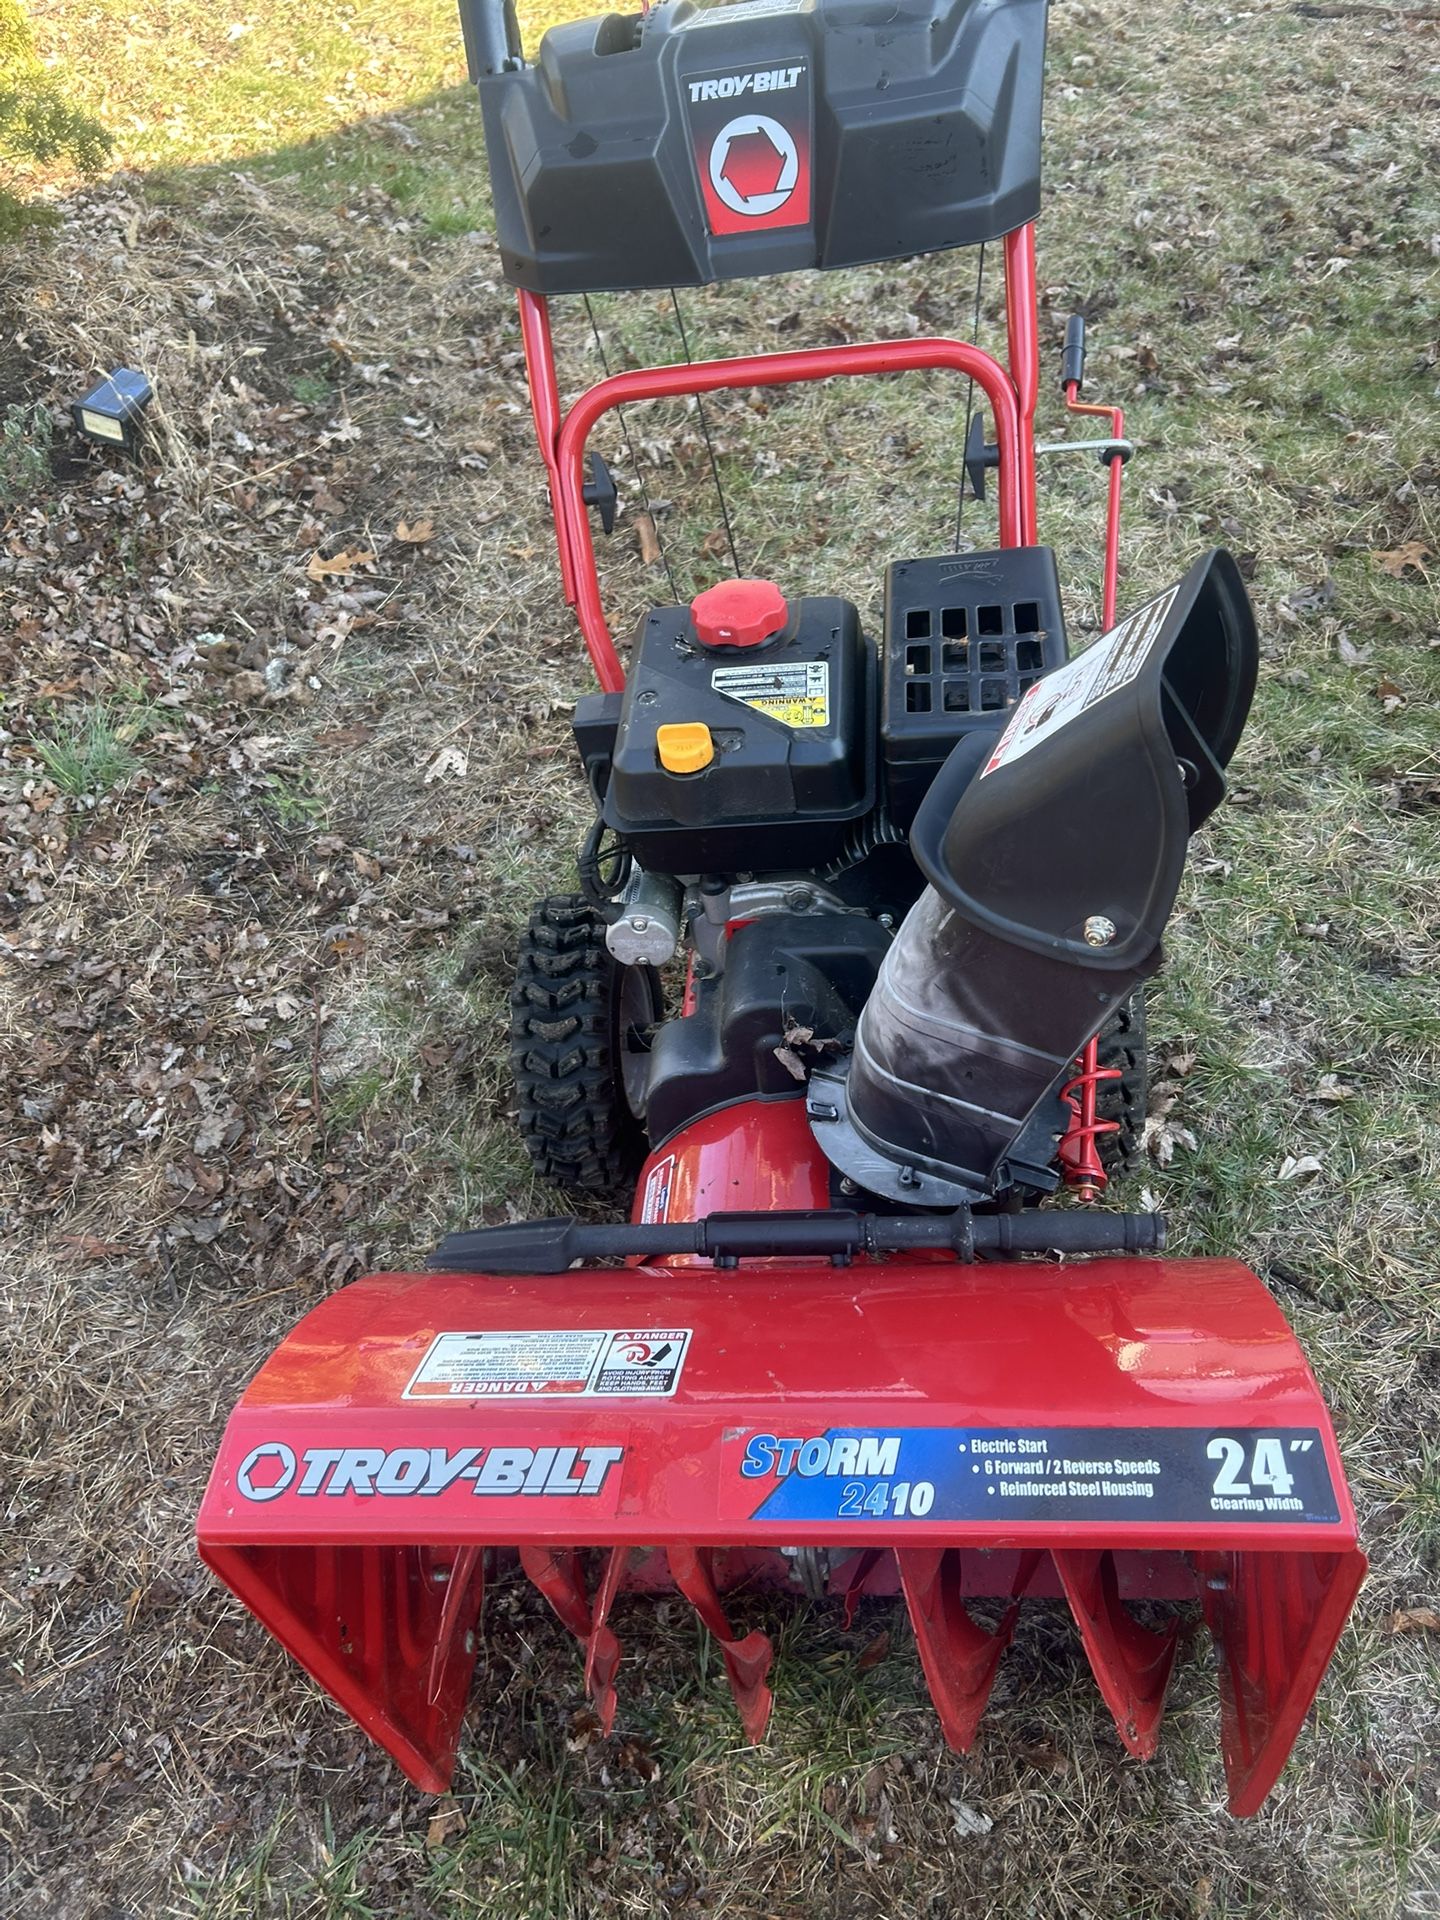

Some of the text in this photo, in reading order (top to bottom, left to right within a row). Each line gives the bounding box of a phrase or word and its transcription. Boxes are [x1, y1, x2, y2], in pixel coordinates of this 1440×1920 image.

[688, 67, 802, 102] TROY-BILT
[632, 1332, 685, 1340] DANGER
[449, 1382, 529, 1393] DANGER
[971, 1439, 1048, 1453] Electric Start
[740, 1434, 901, 1477] STORM
[297, 1447, 625, 1496] TROY-BILT
[984, 1459, 1161, 1475] 6 Forward / 2 Reverse Speeds
[1000, 1481, 1154, 1497] Reinforced Steel Housing
[837, 1481, 935, 1517] 2410
[1210, 1497, 1304, 1511] Clearing Width
